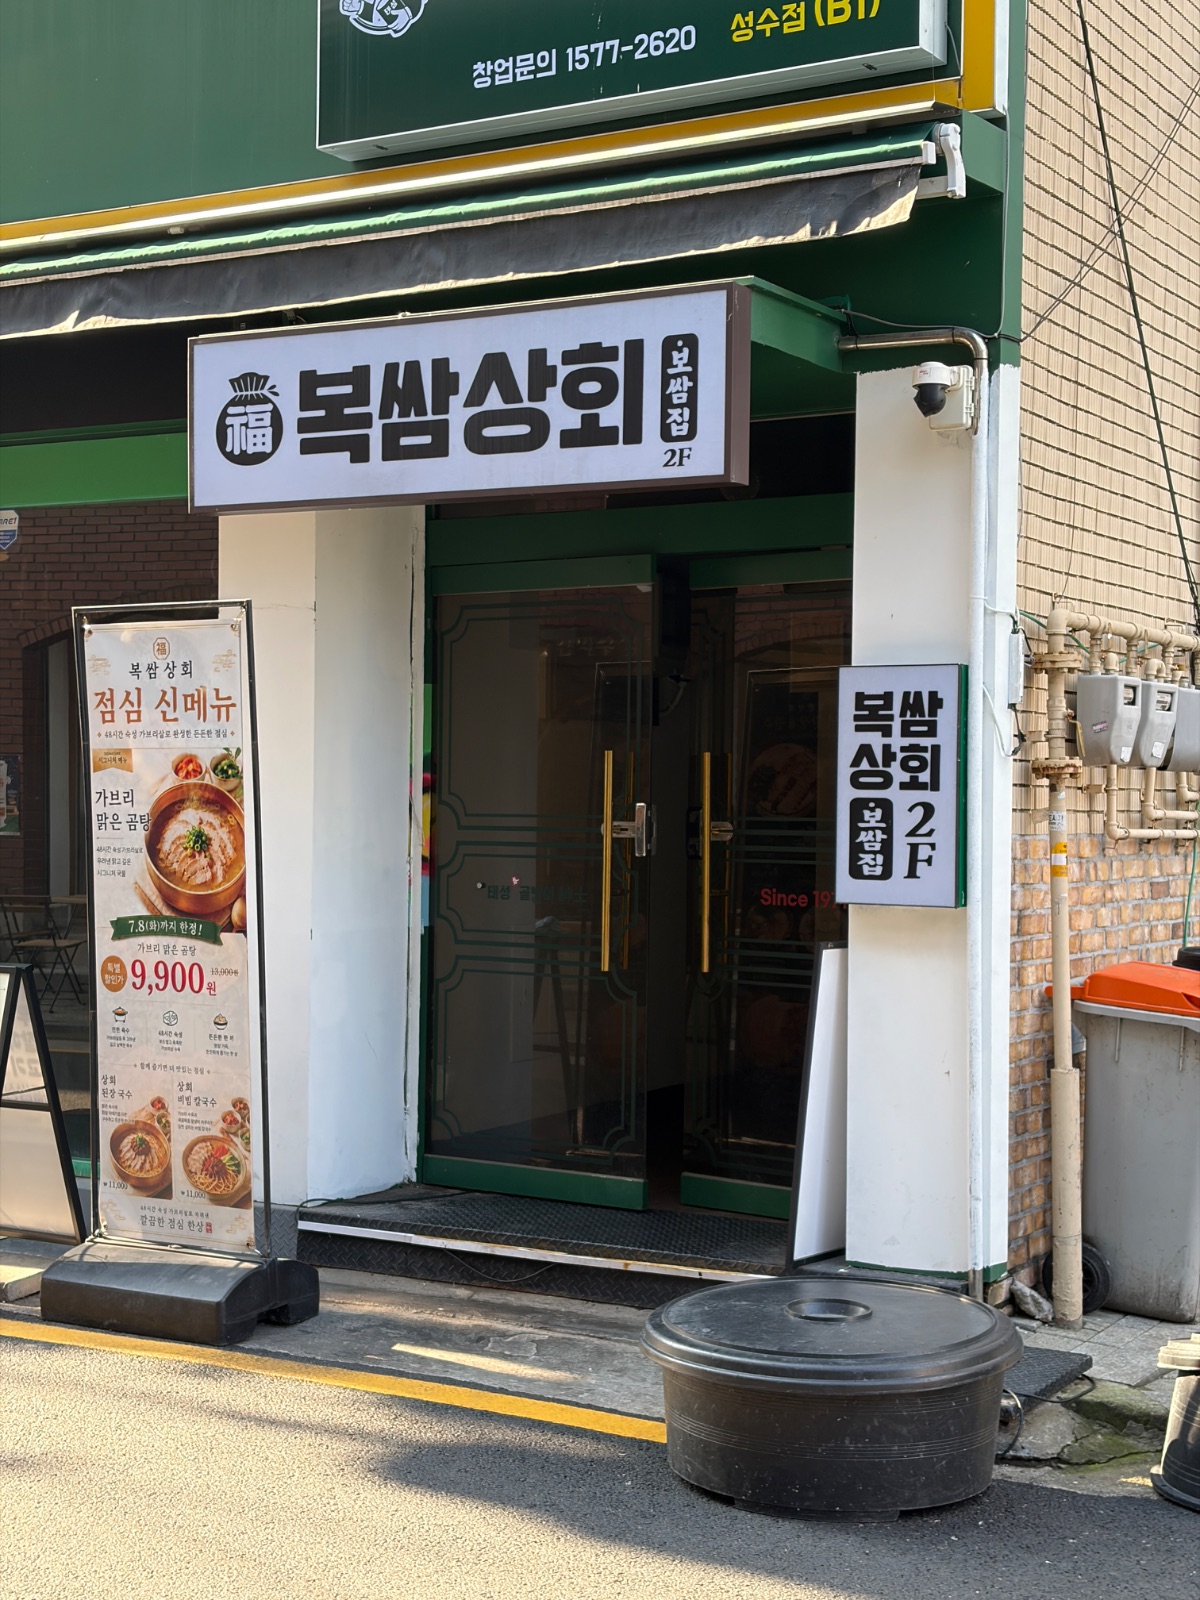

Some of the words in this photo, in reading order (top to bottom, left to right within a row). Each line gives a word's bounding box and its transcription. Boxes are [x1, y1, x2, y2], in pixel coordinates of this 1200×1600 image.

[730, 3, 805, 43] 성수점
[472, 48, 557, 89] 창업문의
[566, 24, 697, 73] 1577-2620
[296, 338, 645, 464] 복쌈상회
[665, 346, 694, 437] 보쌈집
[225, 402, 274, 456] 福
[662, 447, 692, 468] 2F
[128, 660, 193, 680] 복쌈상회
[93, 686, 143, 725] 점심
[154, 685, 237, 723] 신메뉴
[852, 690, 944, 738] 복쌈
[104, 730, 124, 740] 48시간
[125, 730, 138, 739] 숙성
[140, 729, 171, 739] 가브리살로
[173, 729, 192, 739] 완성한
[193, 728, 213, 739] 든든한
[214, 728, 228, 738] 점심
[849, 743, 941, 792] 상회
[95, 788, 135, 808] 가브리
[96, 813, 123, 832] 맑은
[125, 813, 152, 832] 곰탕
[855, 807, 888, 877] 보쌈집
[487, 884, 511, 900] 태성
[760, 887, 809, 908] Since
[128, 919, 177, 934] 7.8(화)까지
[179, 921, 203, 936] 한정!
[137, 942, 160, 955] 가브리
[162, 944, 179, 956] 맑은
[180, 945, 197, 957] 곰탕
[107, 962, 121, 974] 특별
[104, 974, 125, 985] 할인가
[101, 1074, 117, 1086] 상회
[177, 1081, 193, 1093] 상회
[101, 1088, 117, 1100] 된장
[117, 1089, 133, 1100] 국수
[177, 1094, 192, 1107] 비빔
[193, 1096, 218, 1109] 칼국수
[140, 1214, 165, 1229] 깔끔한
[168, 1217, 184, 1231] 점심
[187, 1219, 204, 1233] 한상
